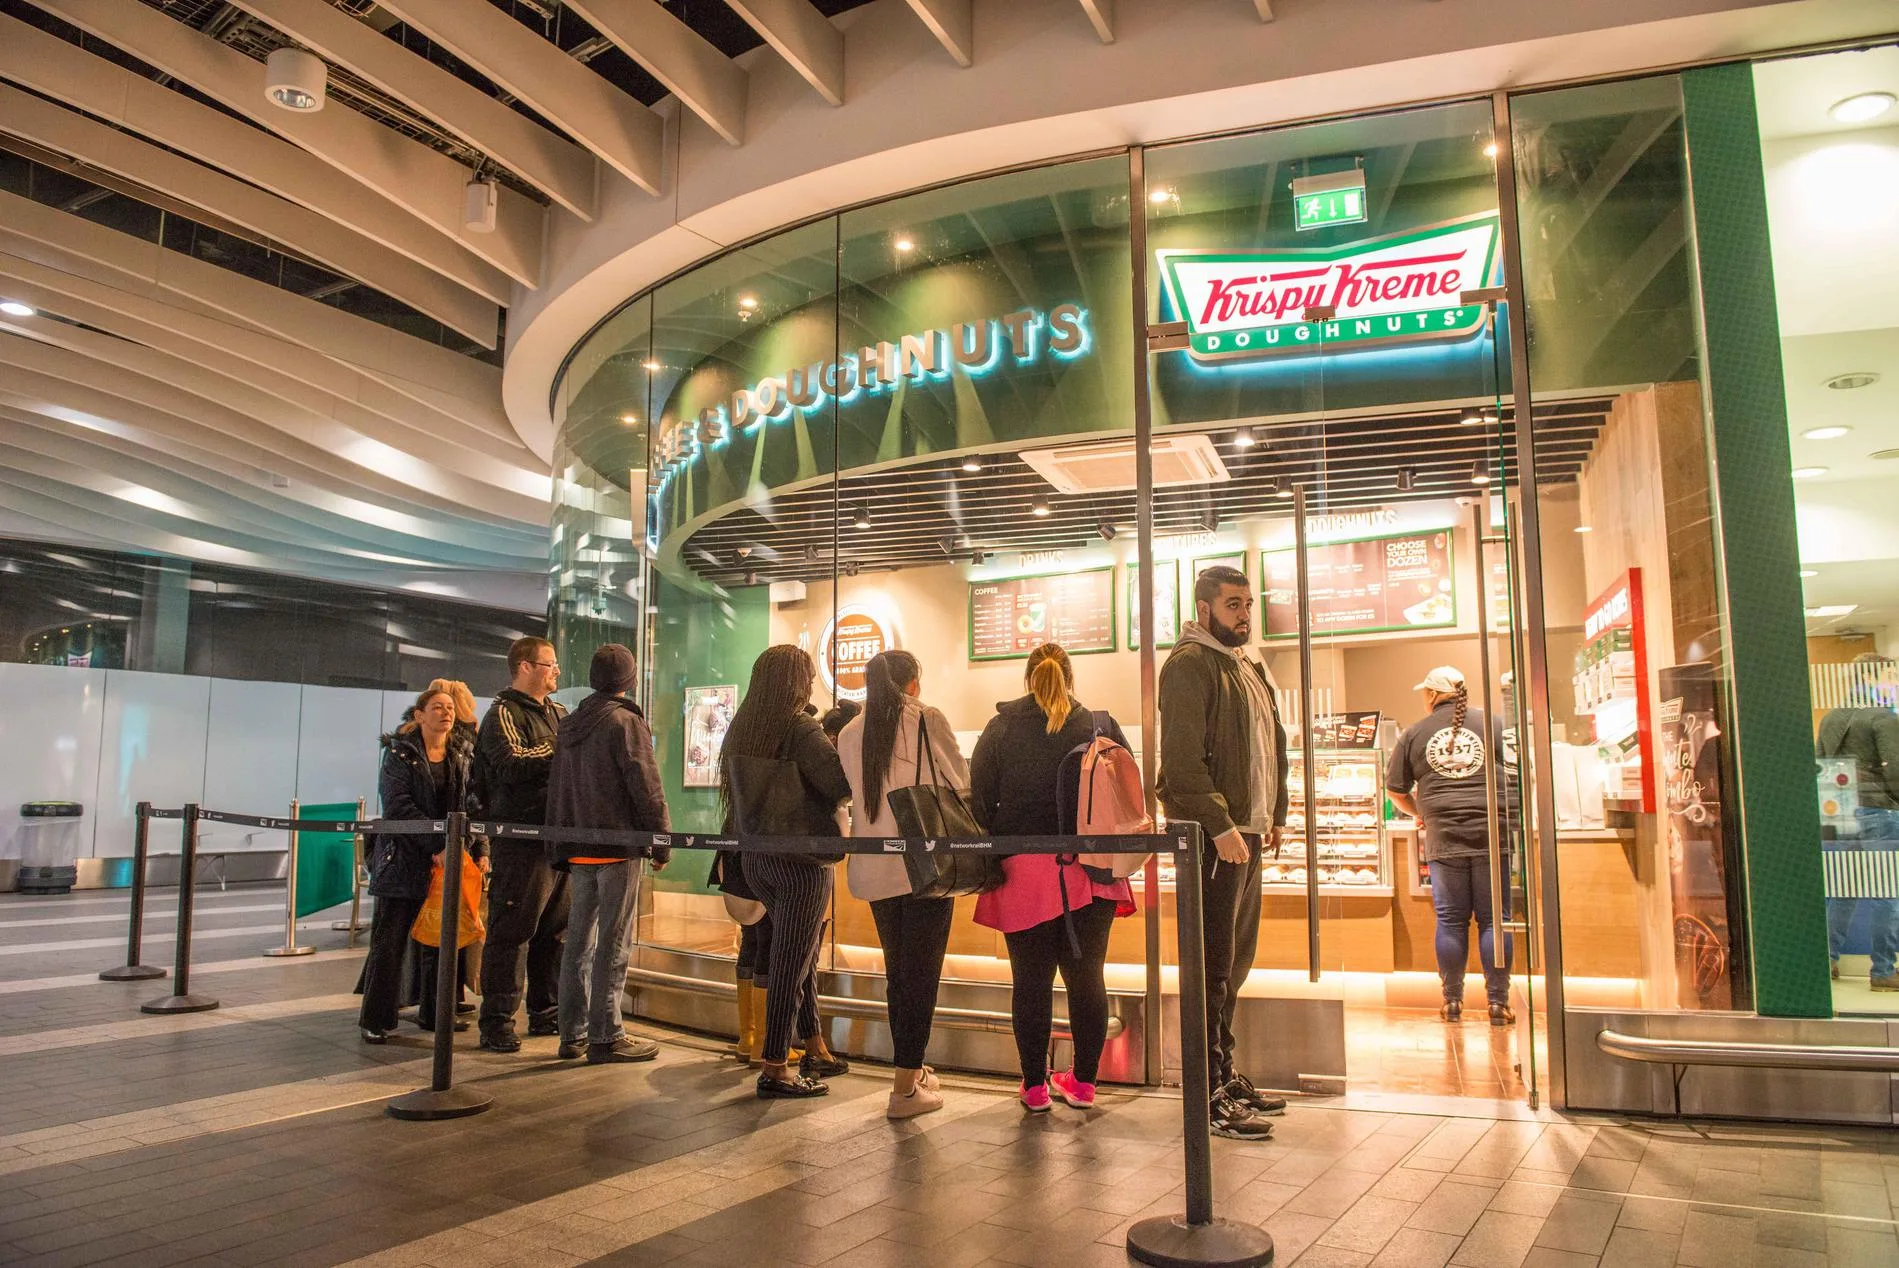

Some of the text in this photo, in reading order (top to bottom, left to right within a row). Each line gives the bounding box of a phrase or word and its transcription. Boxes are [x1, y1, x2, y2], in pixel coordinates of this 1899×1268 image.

[1200, 248, 1468, 324] Krispy Kreme
[1206, 310, 1456, 350] DOUGHNUTS
[731, 302, 1083, 428] DOUGHNUTS
[1386, 539, 1427, 551] CHOOSE
[1386, 548, 1427, 558] YOUR OWN
[1387, 554, 1428, 568] DOZEN
[974, 587, 998, 596] COFFEE
